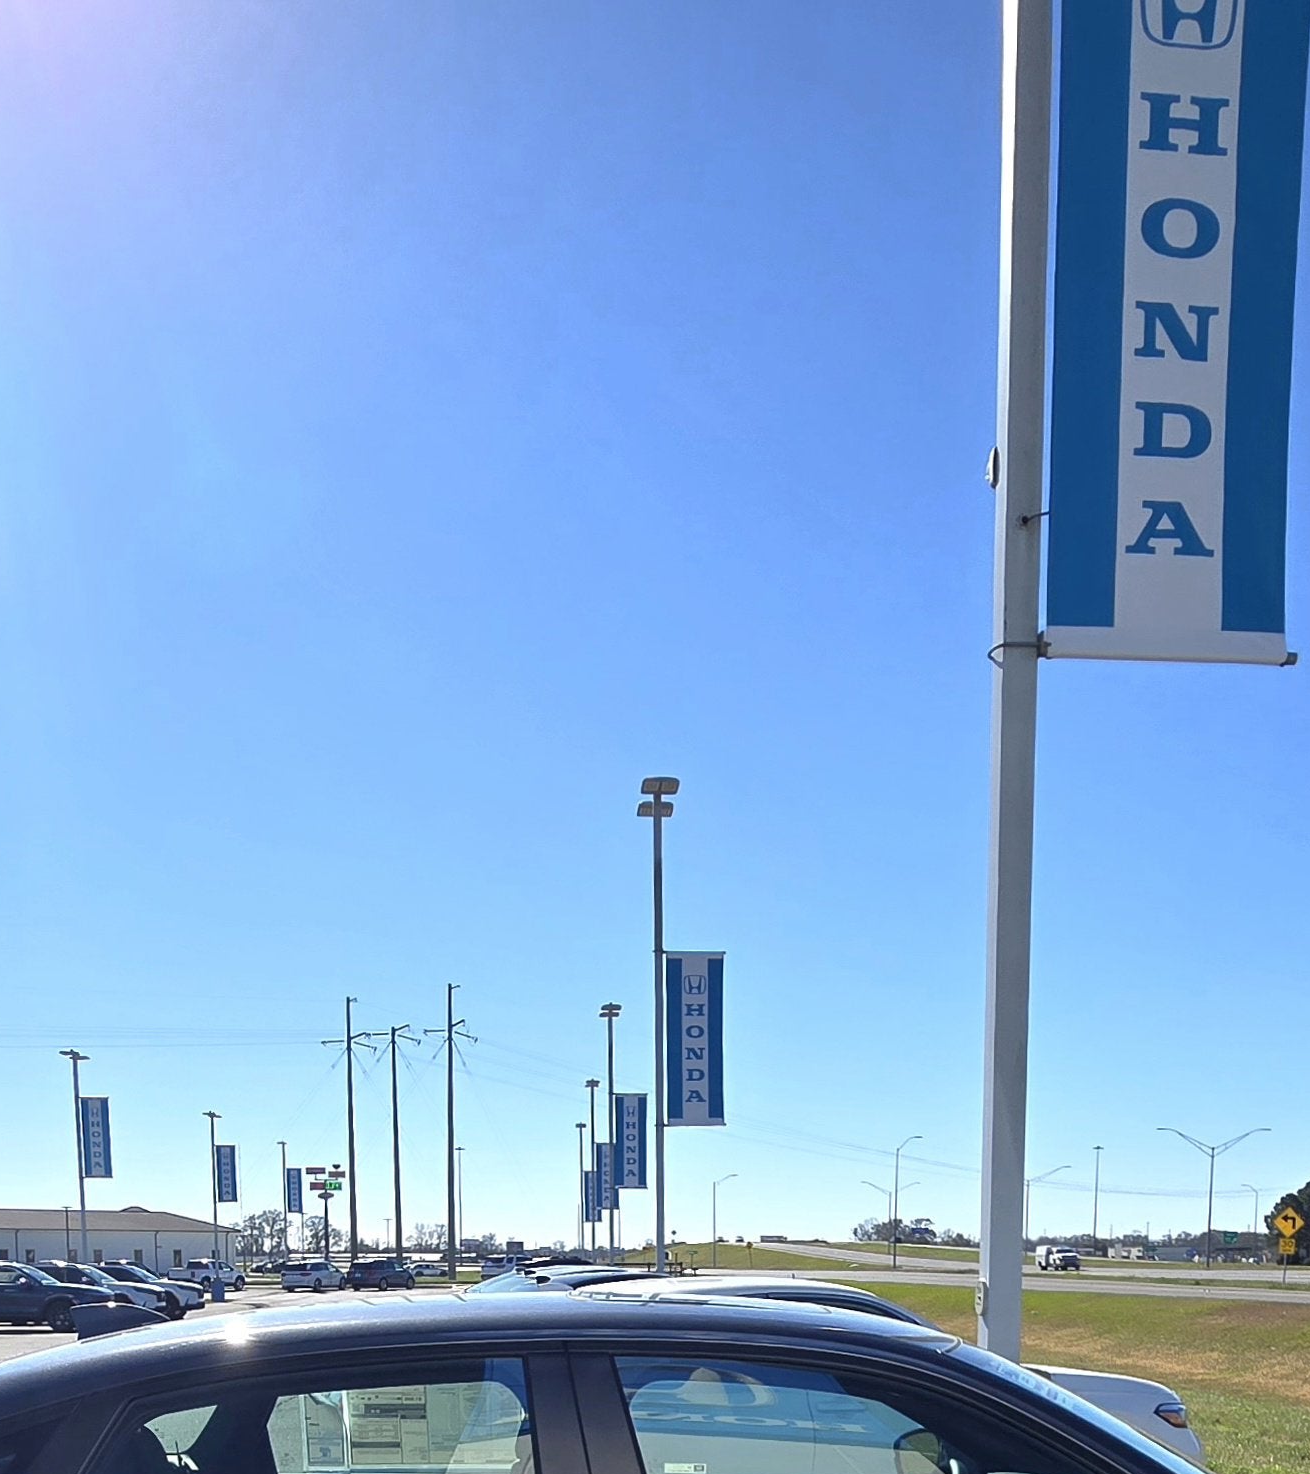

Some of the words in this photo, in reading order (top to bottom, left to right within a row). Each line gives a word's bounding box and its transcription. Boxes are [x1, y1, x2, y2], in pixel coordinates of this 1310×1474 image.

[1125, 91, 1230, 558] HONDA
[684, 1003, 707, 1102] HONDA
[91, 1120, 103, 1168] HONDA
[625, 1121, 637, 1177] HONDA
